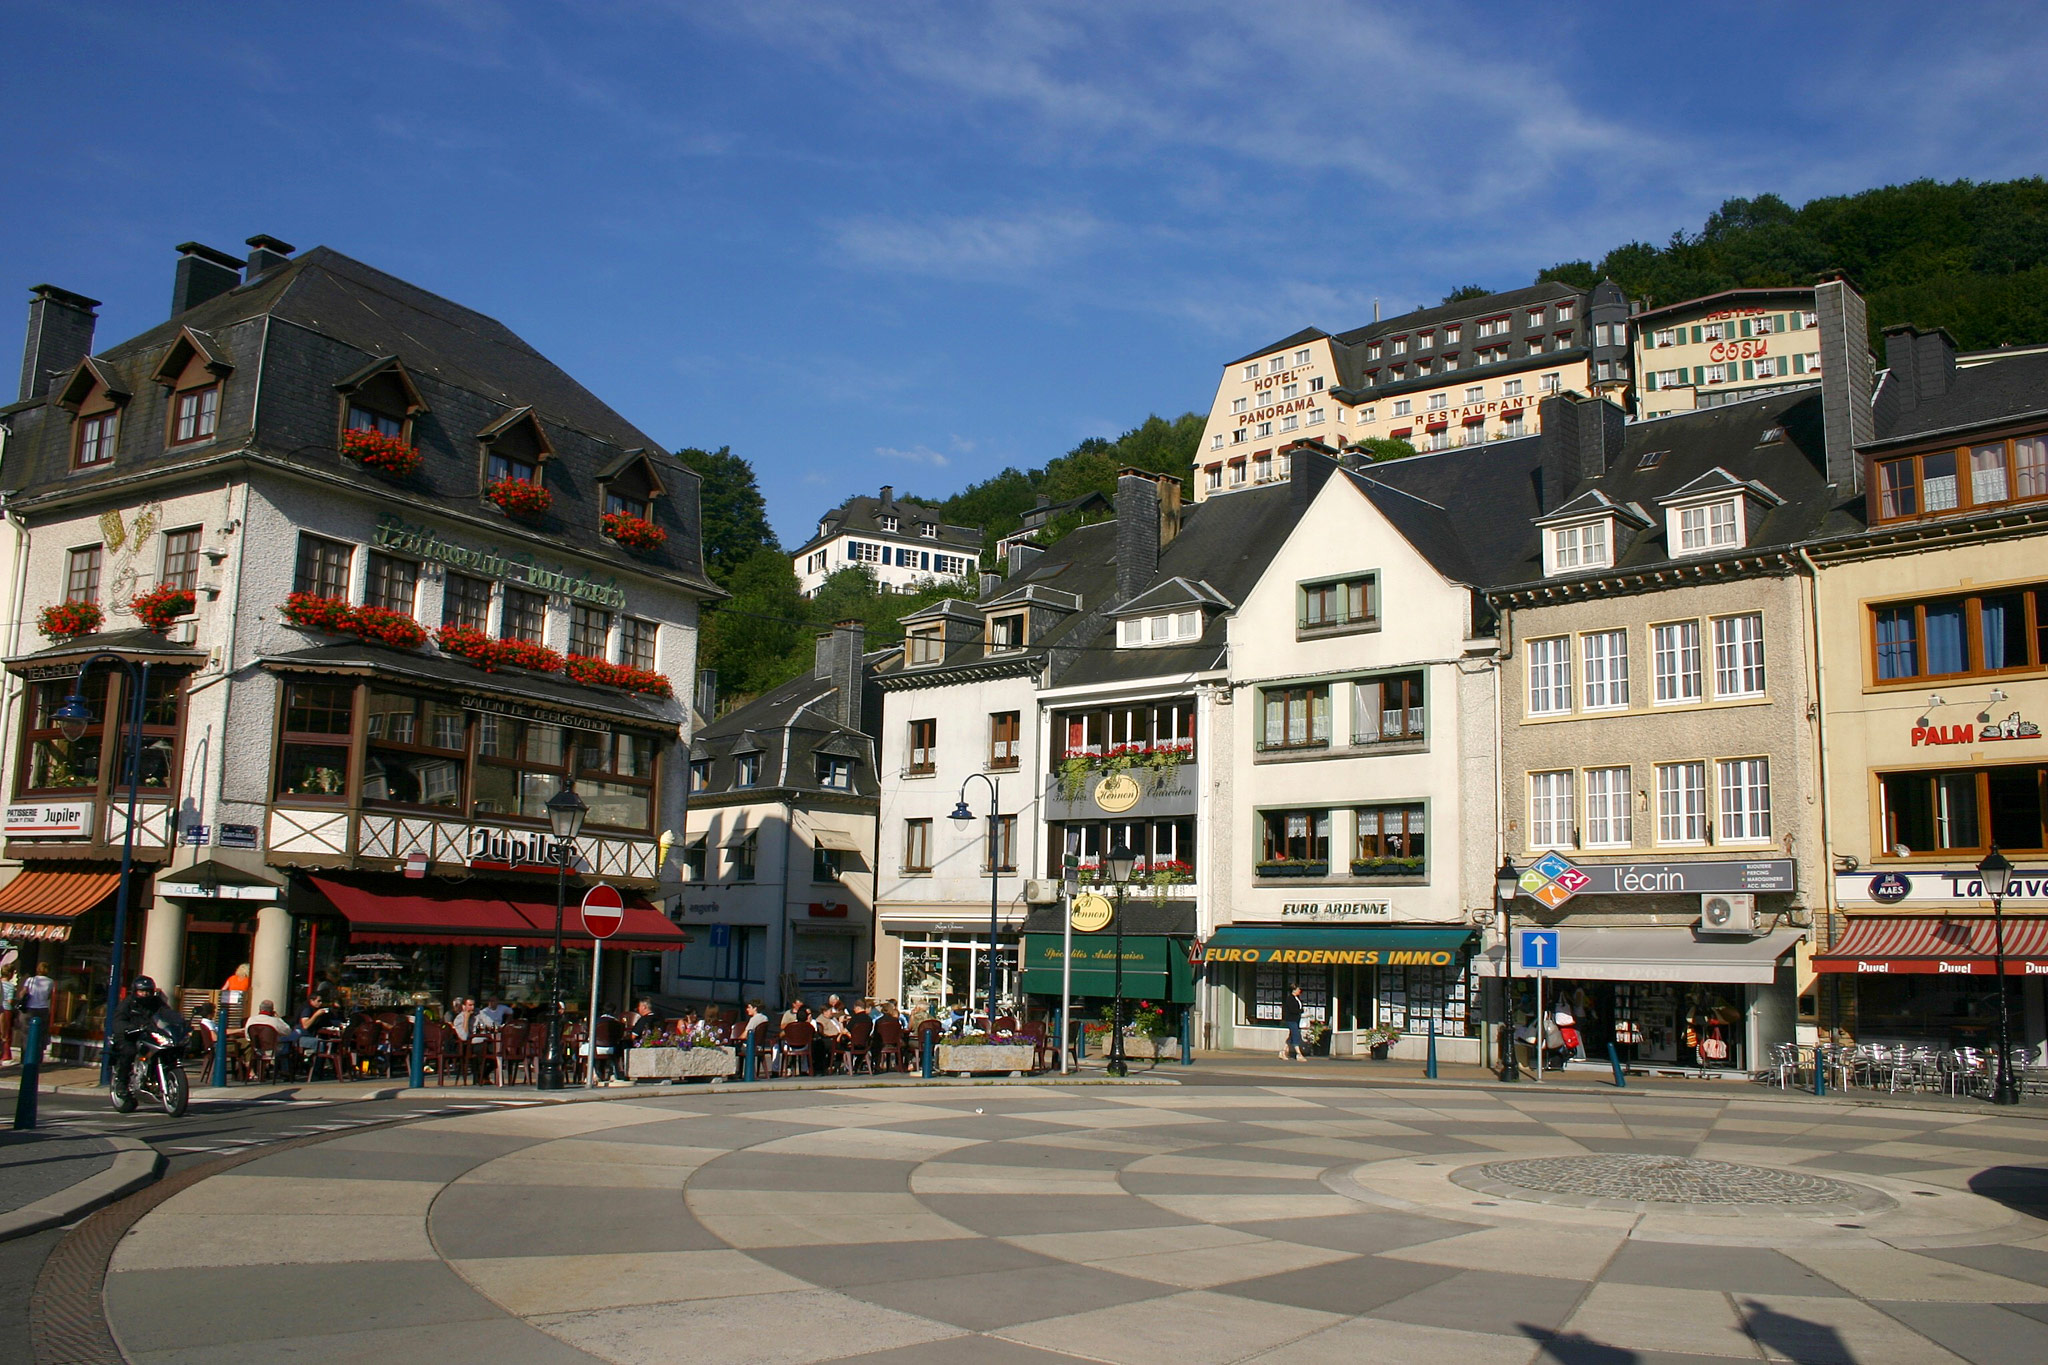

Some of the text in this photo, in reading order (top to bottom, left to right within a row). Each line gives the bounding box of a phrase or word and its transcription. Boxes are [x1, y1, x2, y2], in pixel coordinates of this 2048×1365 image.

[1710, 339, 1768, 363] COSY
[1254, 370, 1298, 392] HOTEL
[1239, 396, 1315, 427] PANORAMA
[1415, 395, 1535, 426] RESTAURANT
[461, 695, 611, 732] SALON DE DEGUSTATION
[1911, 723, 1974, 747] PALM
[44, 808, 81, 825] Jupiler
[467, 826, 578, 869] Jupiler
[1614, 866, 1684, 892] l'écrin
[1878, 885, 1904, 895] MAES
[1953, 878, 1983, 897] La
[1282, 902, 1388, 915] EURO ARDENNE
[1044, 947, 1088, 960] Spéclités
[1204, 948, 1451, 966] EURO ARDENNES IMMO
[1857, 961, 1889, 974] Duvel
[1939, 961, 1971, 974] Duvel
